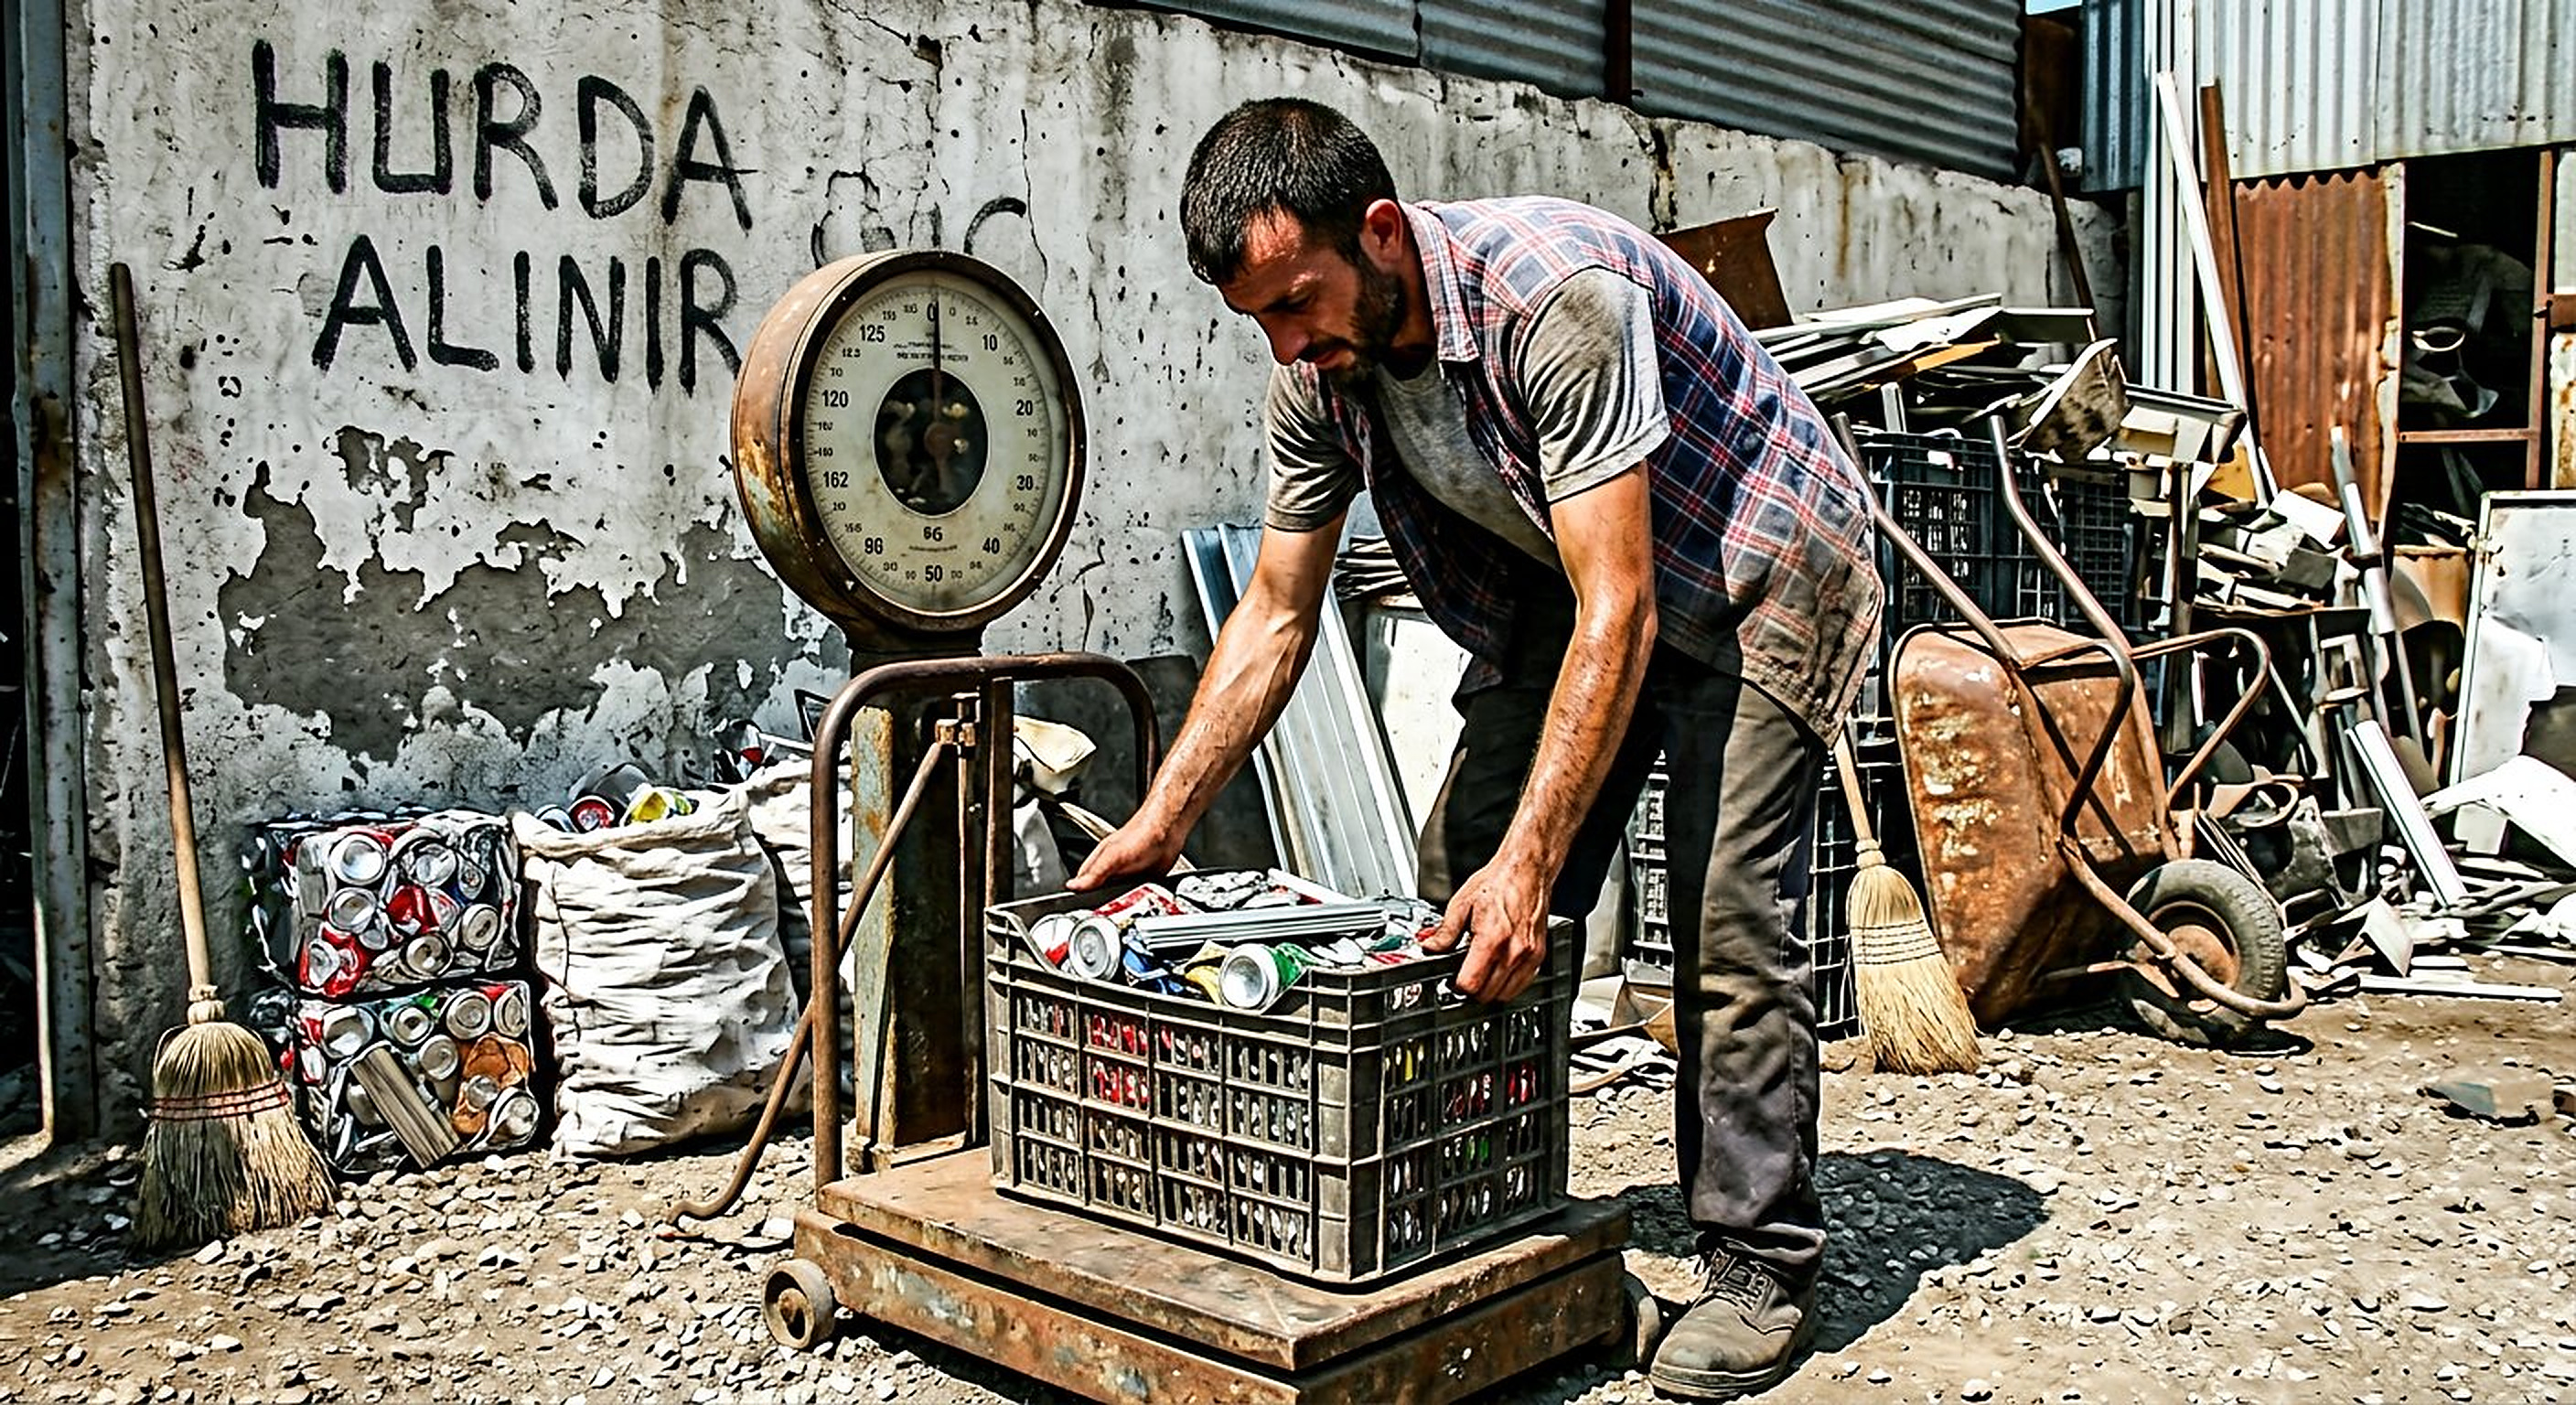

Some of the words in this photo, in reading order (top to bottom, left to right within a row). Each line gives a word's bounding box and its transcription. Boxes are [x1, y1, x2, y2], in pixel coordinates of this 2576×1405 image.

[252, 39, 758, 232] HURDA
[312, 235, 741, 395] ALINIR
[860, 324, 886, 342] 125
[982, 334, 998, 351] 10
[821, 390, 849, 407] 120
[1015, 399, 1033, 415] 20
[822, 471, 849, 488] 162
[982, 537, 1000, 554] 40
[924, 564, 943, 582] 50
